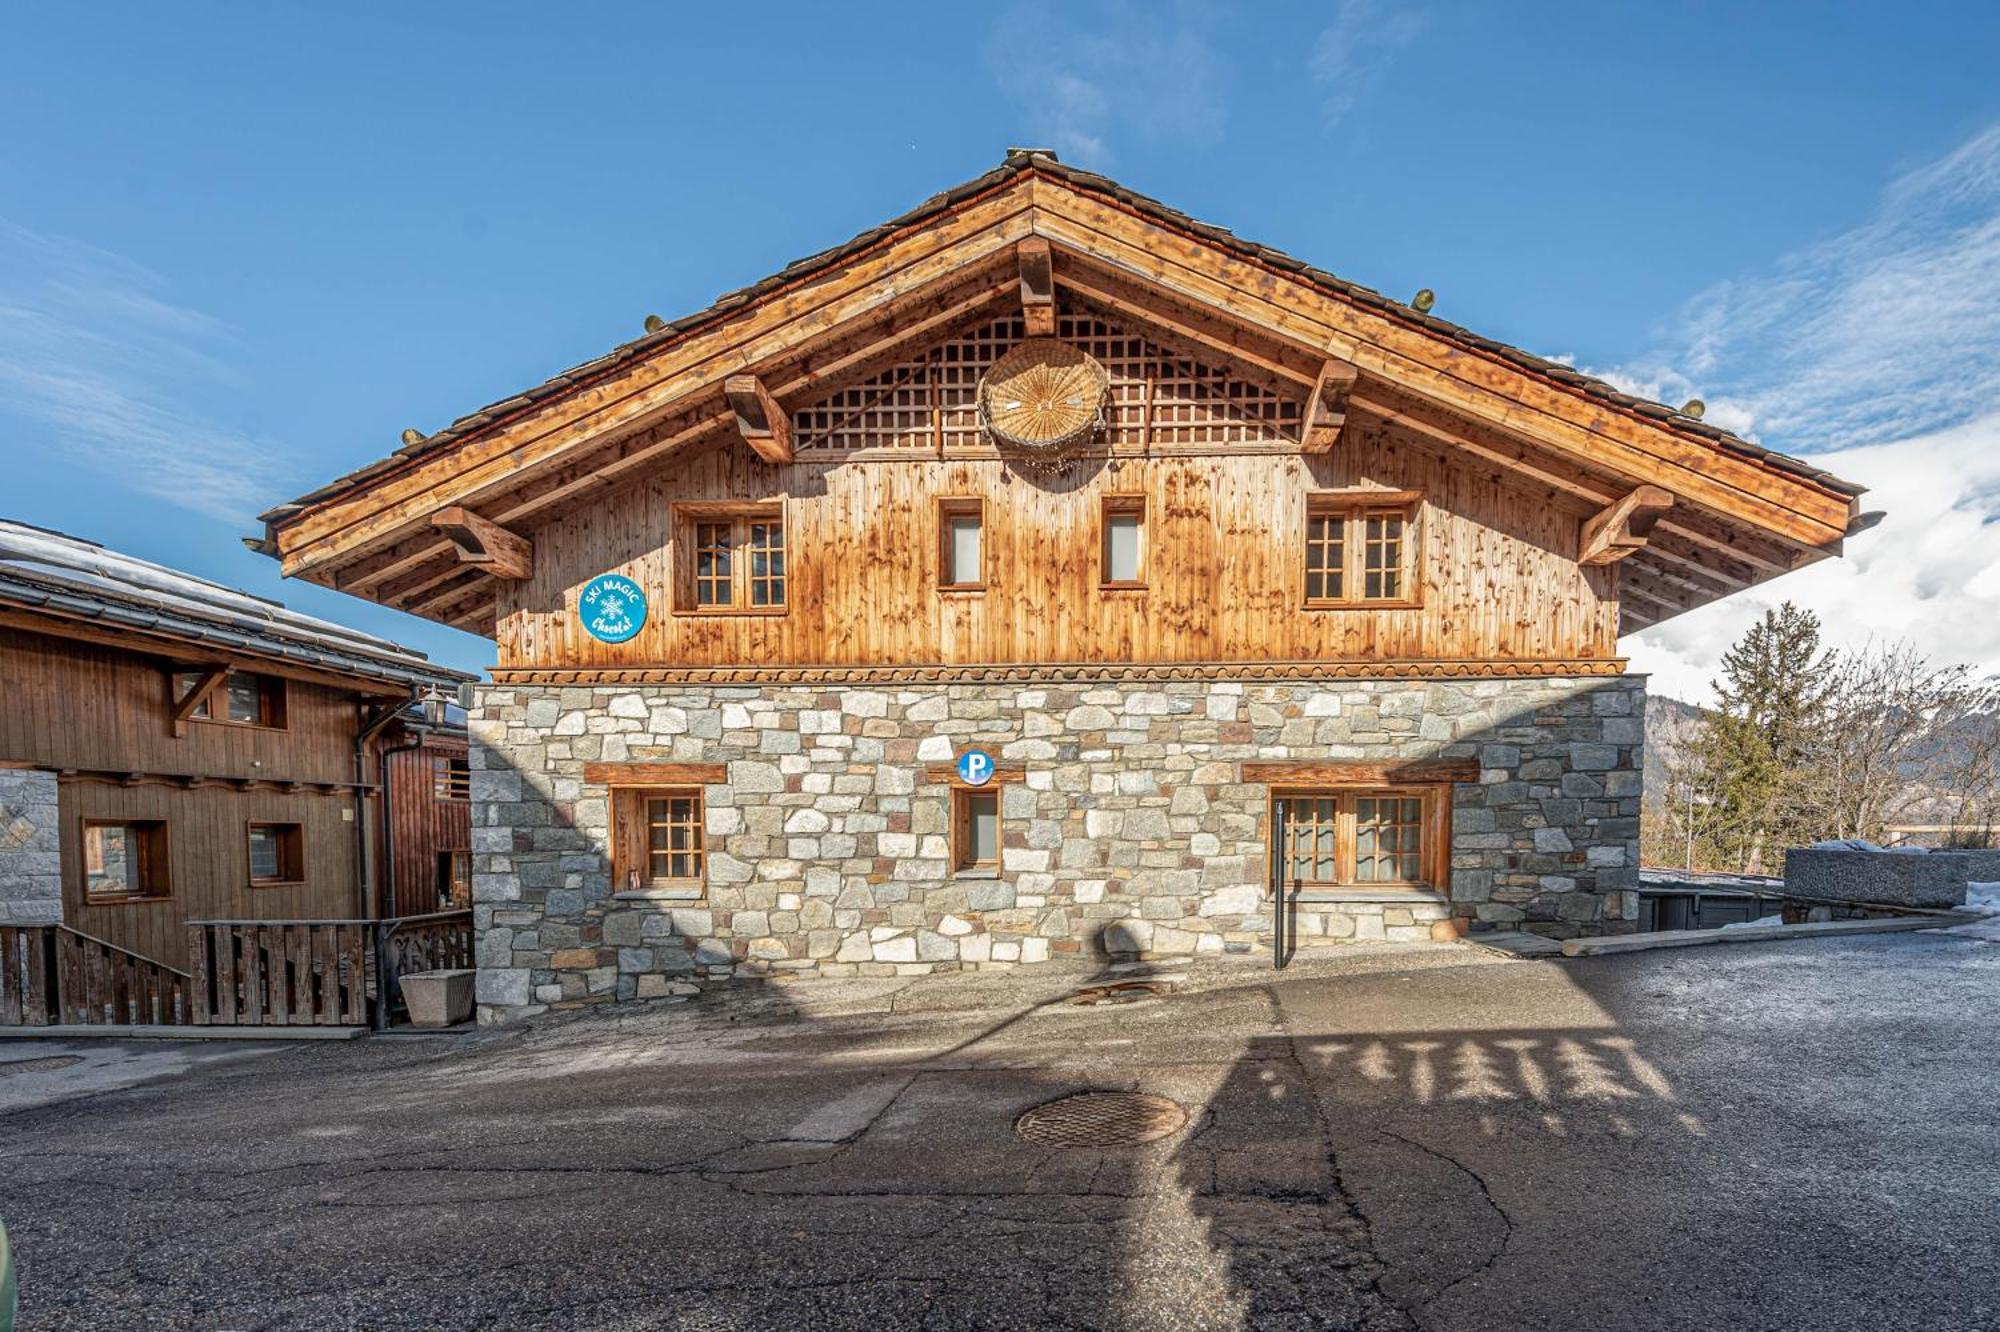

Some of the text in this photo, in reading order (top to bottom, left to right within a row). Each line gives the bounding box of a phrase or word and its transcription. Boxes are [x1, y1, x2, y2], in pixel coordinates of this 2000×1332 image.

[585, 580, 639, 604] SKI MAGIC
[969, 754, 986, 779] P
